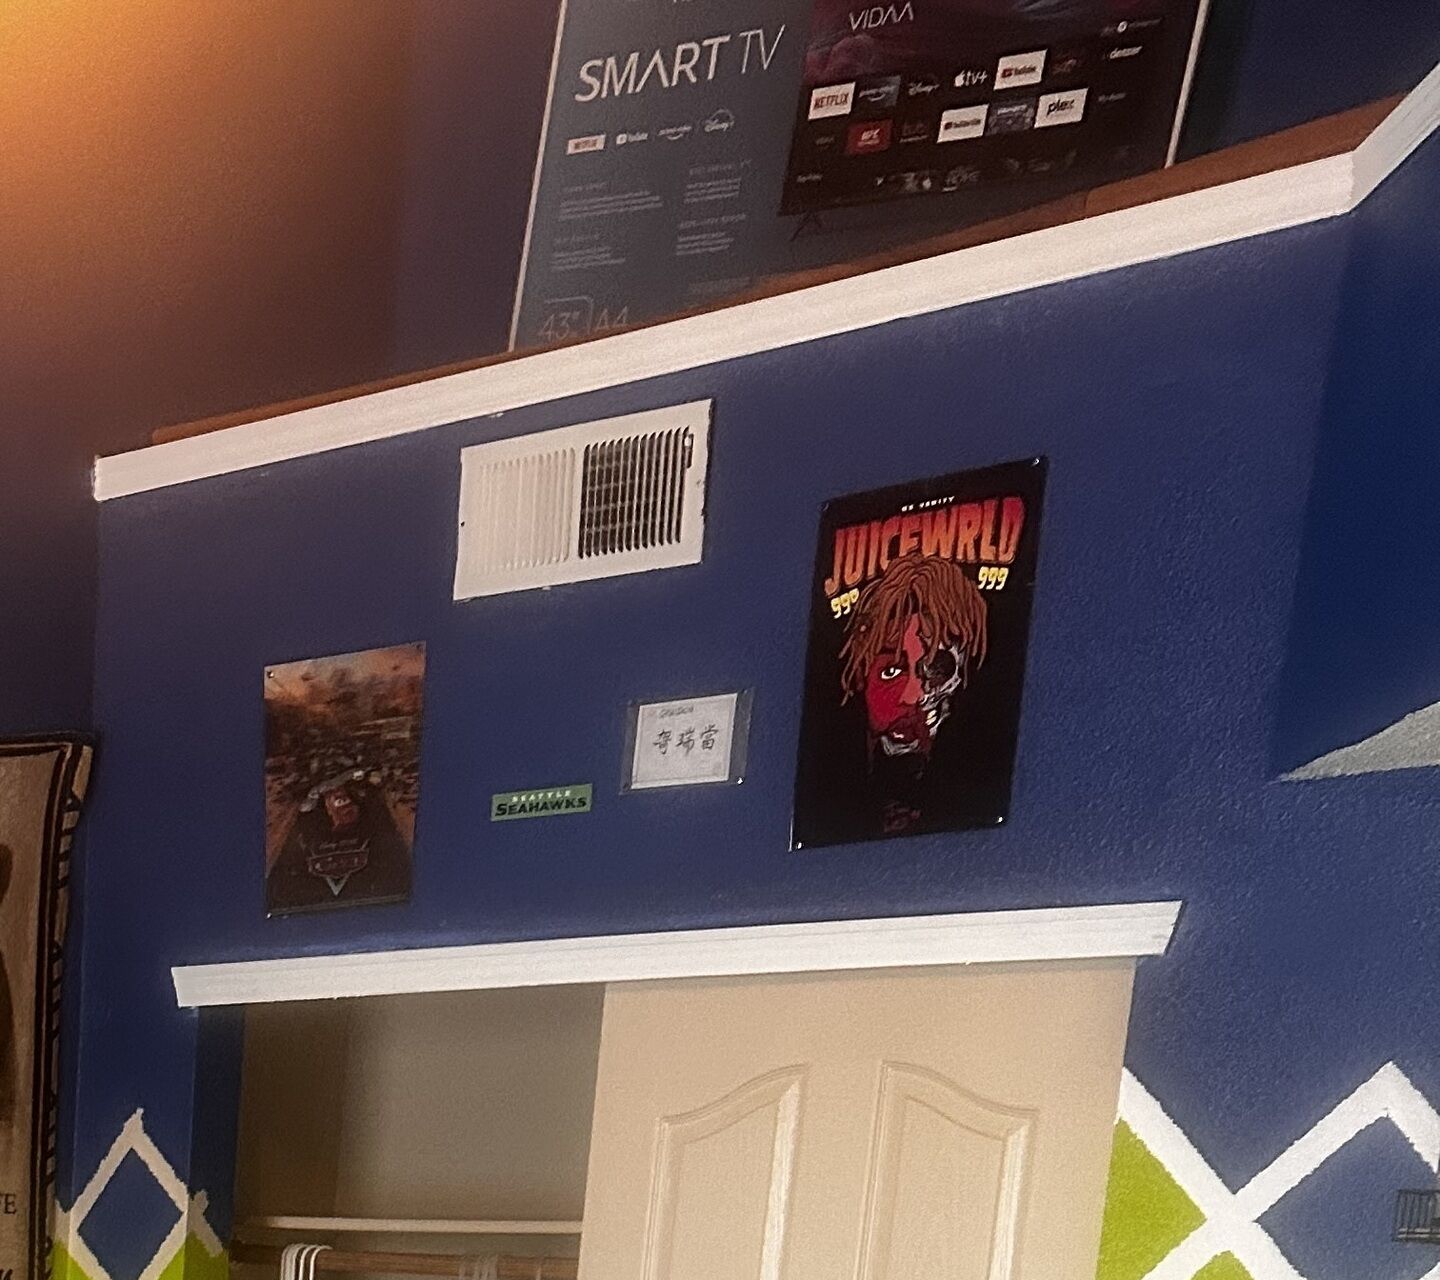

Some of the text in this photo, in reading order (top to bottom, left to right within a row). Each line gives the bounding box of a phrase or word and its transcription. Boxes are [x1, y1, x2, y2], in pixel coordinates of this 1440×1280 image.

[849, 1, 914, 31] VIDAA
[575, 24, 787, 101] SMART TV
[813, 92, 850, 110] NETFLIX
[978, 566, 1009, 590] 999
[495, 797, 588, 816] SEAHAWKS
[512, 789, 572, 803] SEATTLE
